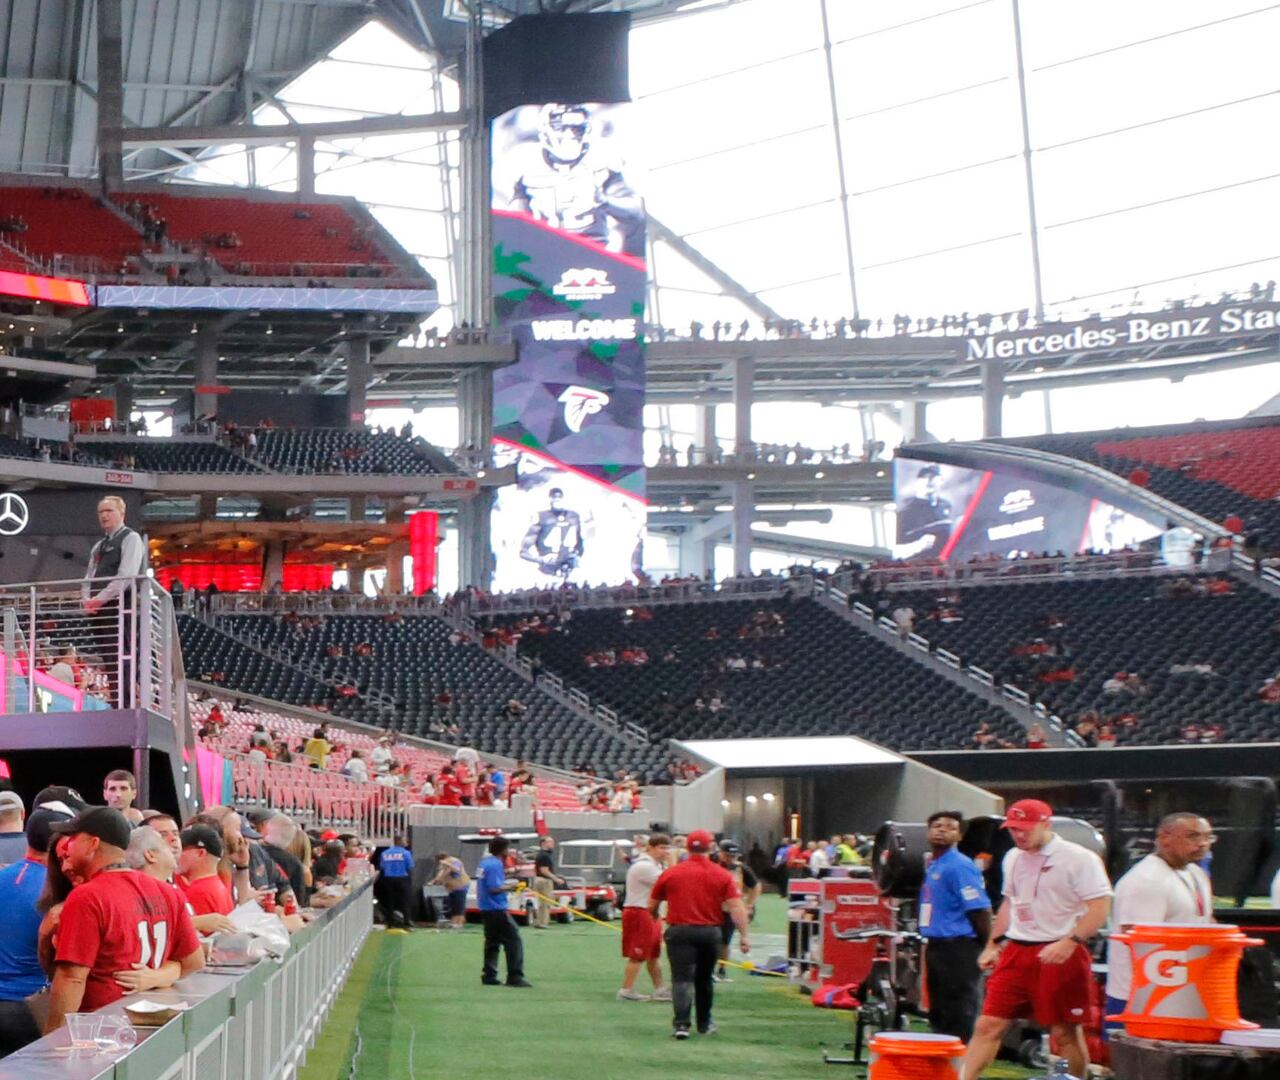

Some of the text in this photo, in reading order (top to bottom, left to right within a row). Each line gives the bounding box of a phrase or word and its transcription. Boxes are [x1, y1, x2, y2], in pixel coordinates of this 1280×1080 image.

[531, 318, 637, 341] WELCOME
[966, 306, 1280, 361] Mercedes-Benz Sta
[137, 920, 168, 969] 11
[1144, 950, 1189, 987] G
